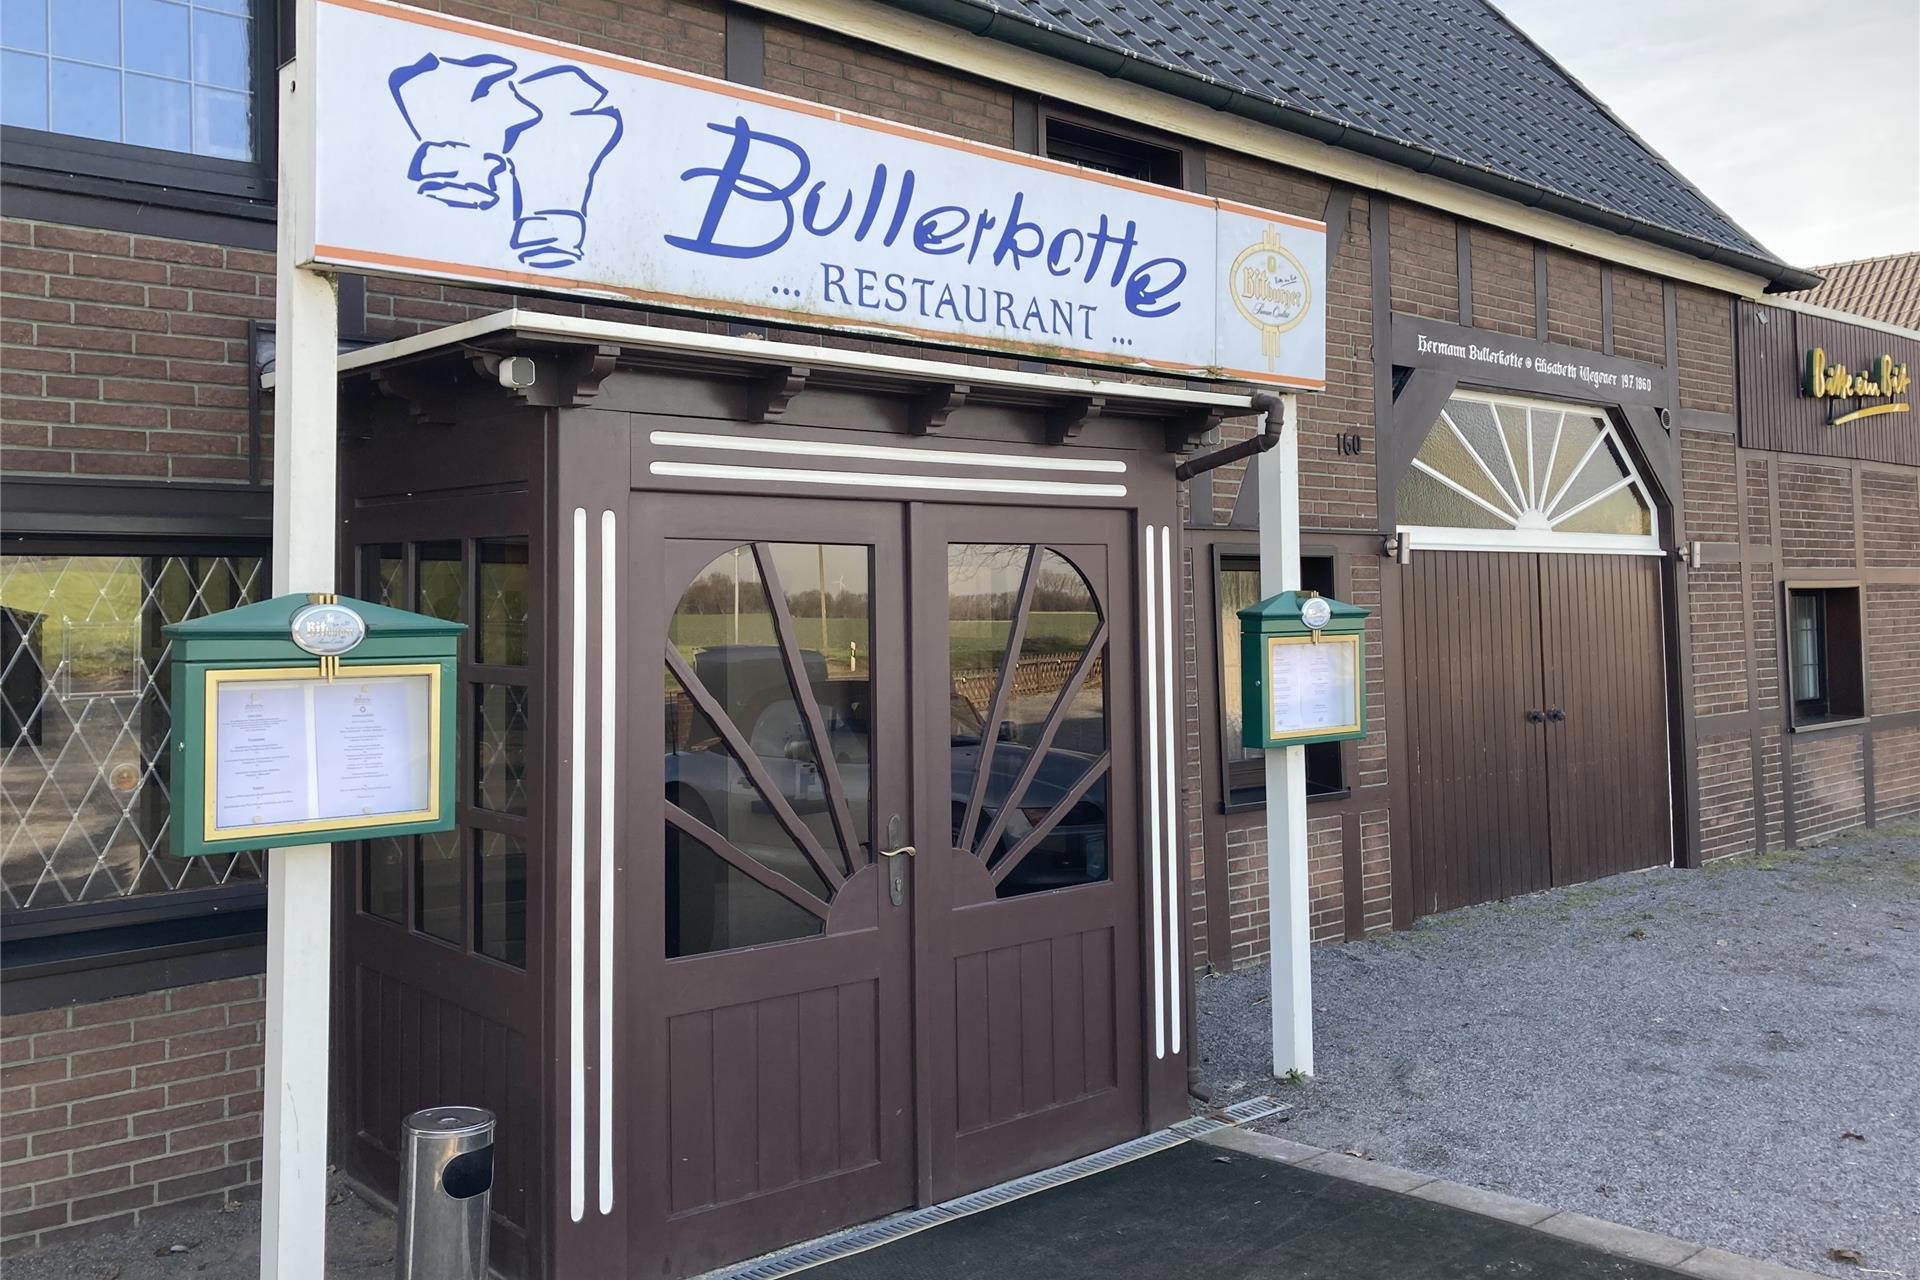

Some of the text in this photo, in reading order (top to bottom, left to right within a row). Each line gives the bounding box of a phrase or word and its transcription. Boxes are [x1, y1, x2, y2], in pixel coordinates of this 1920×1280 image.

[664, 116, 1187, 318] Bullerkotte
[821, 262, 1097, 340] RESTAURANT
[1469, 344, 1524, 368] Bullerkotte
[1881, 354, 1911, 397] Bit
[1336, 432, 1360, 456] 160
